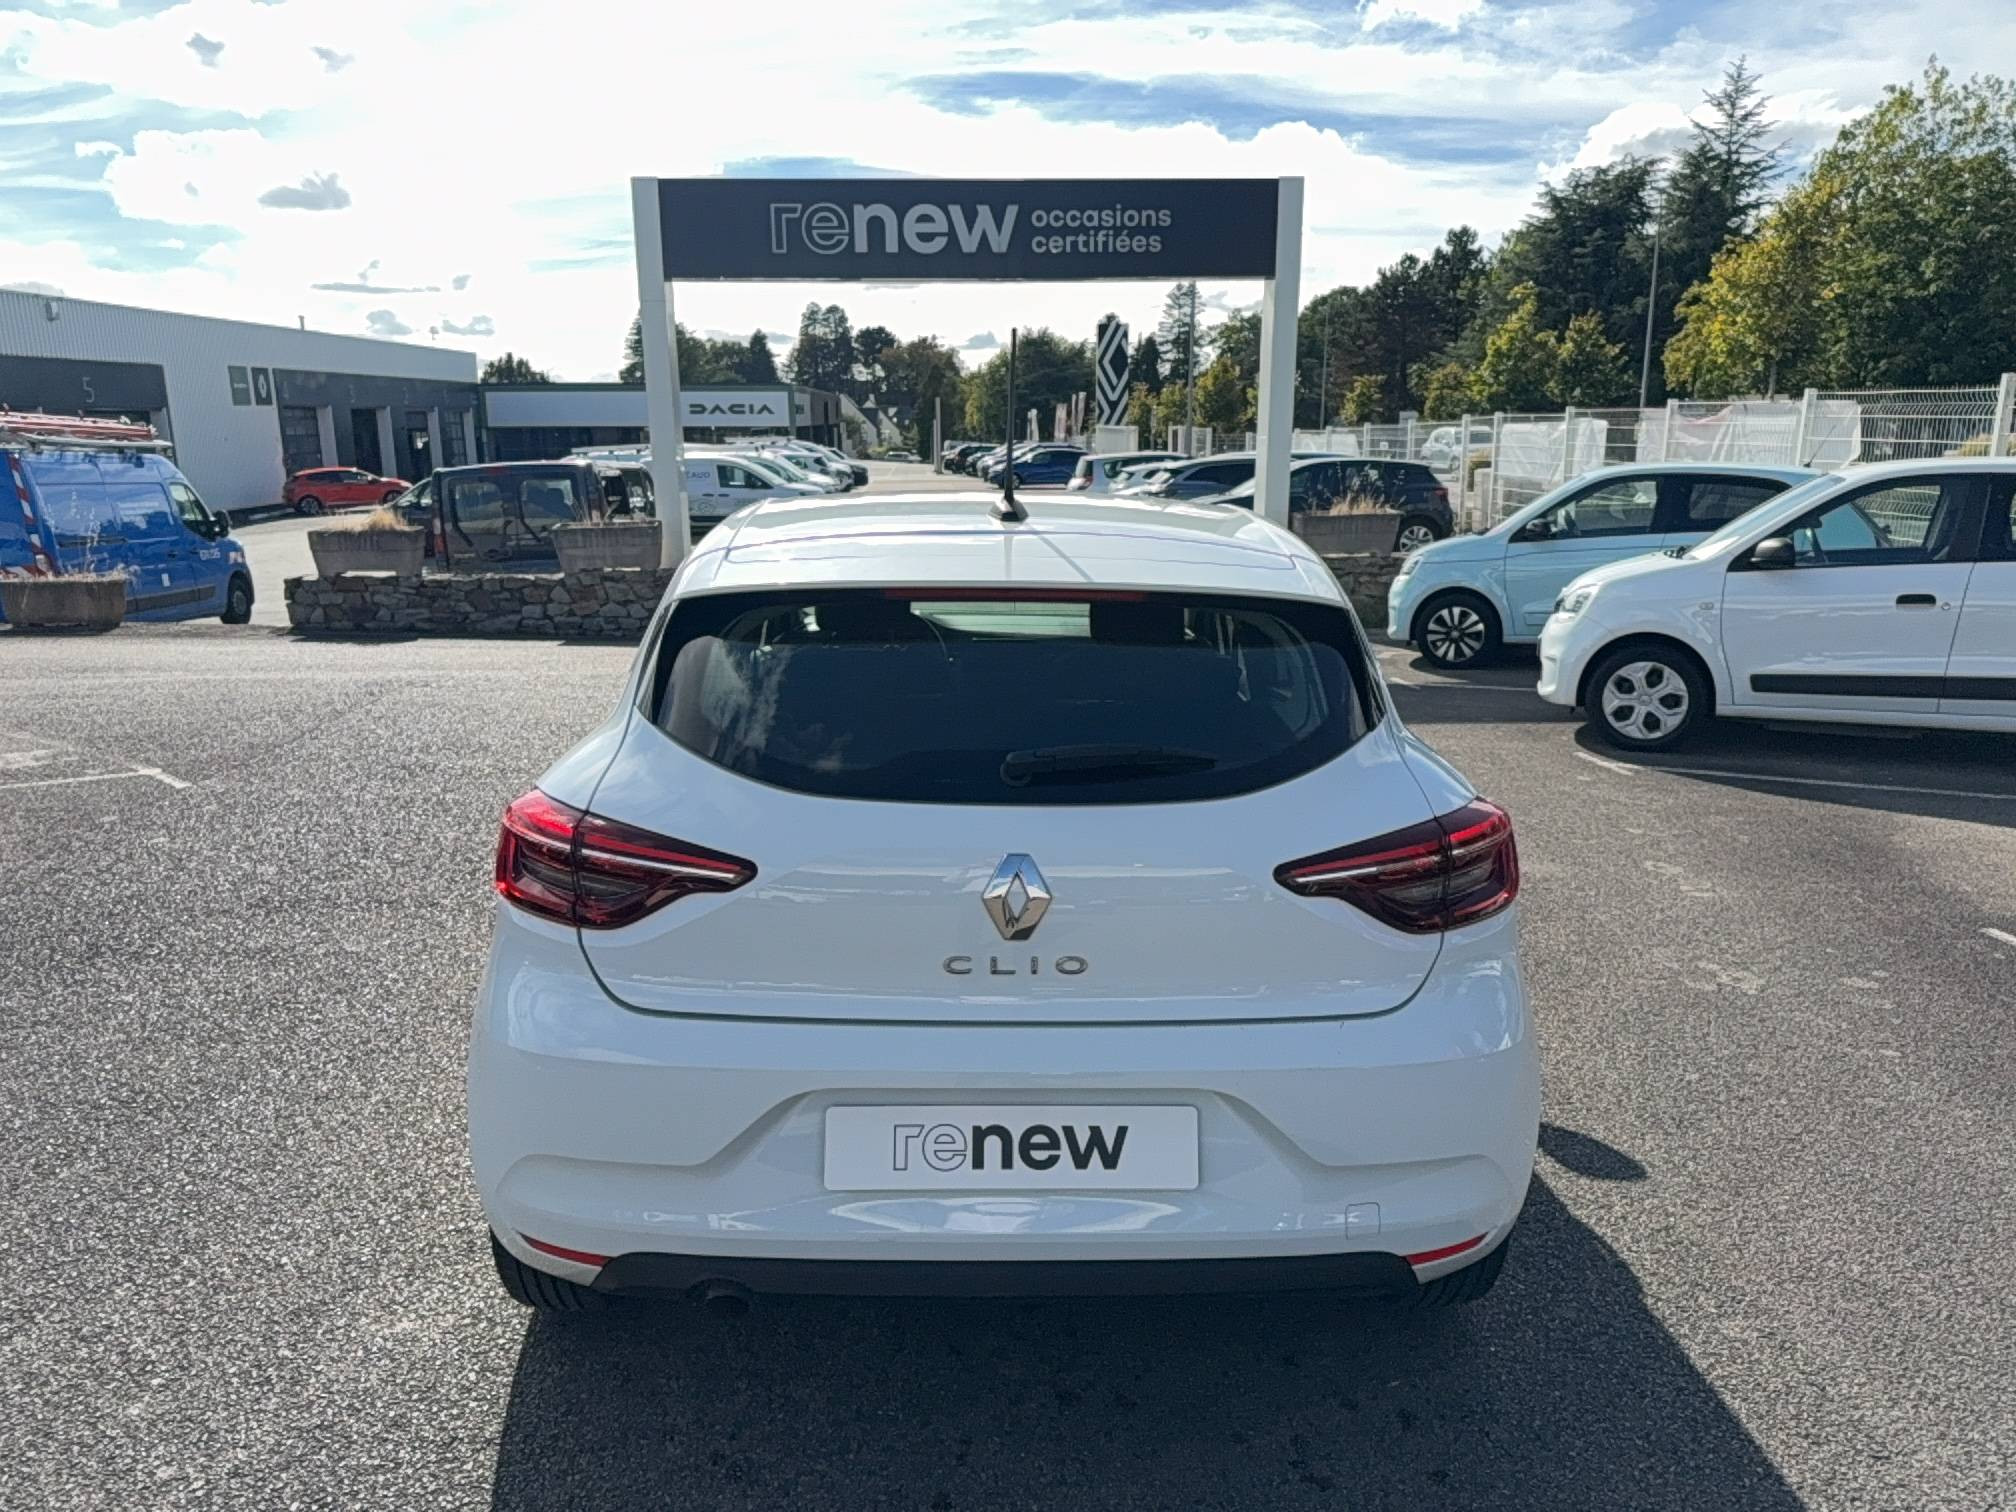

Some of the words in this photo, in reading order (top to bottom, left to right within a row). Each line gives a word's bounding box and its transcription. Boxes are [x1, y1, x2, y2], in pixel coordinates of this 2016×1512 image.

[1031, 203, 1172, 227] occasions
[769, 201, 1019, 255] renew
[1031, 229, 1163, 253] certifiées
[82, 377, 95, 402] 5
[689, 403, 775, 415] DACIA
[942, 955, 1089, 975] CLIO
[892, 1123, 1129, 1172] renew
